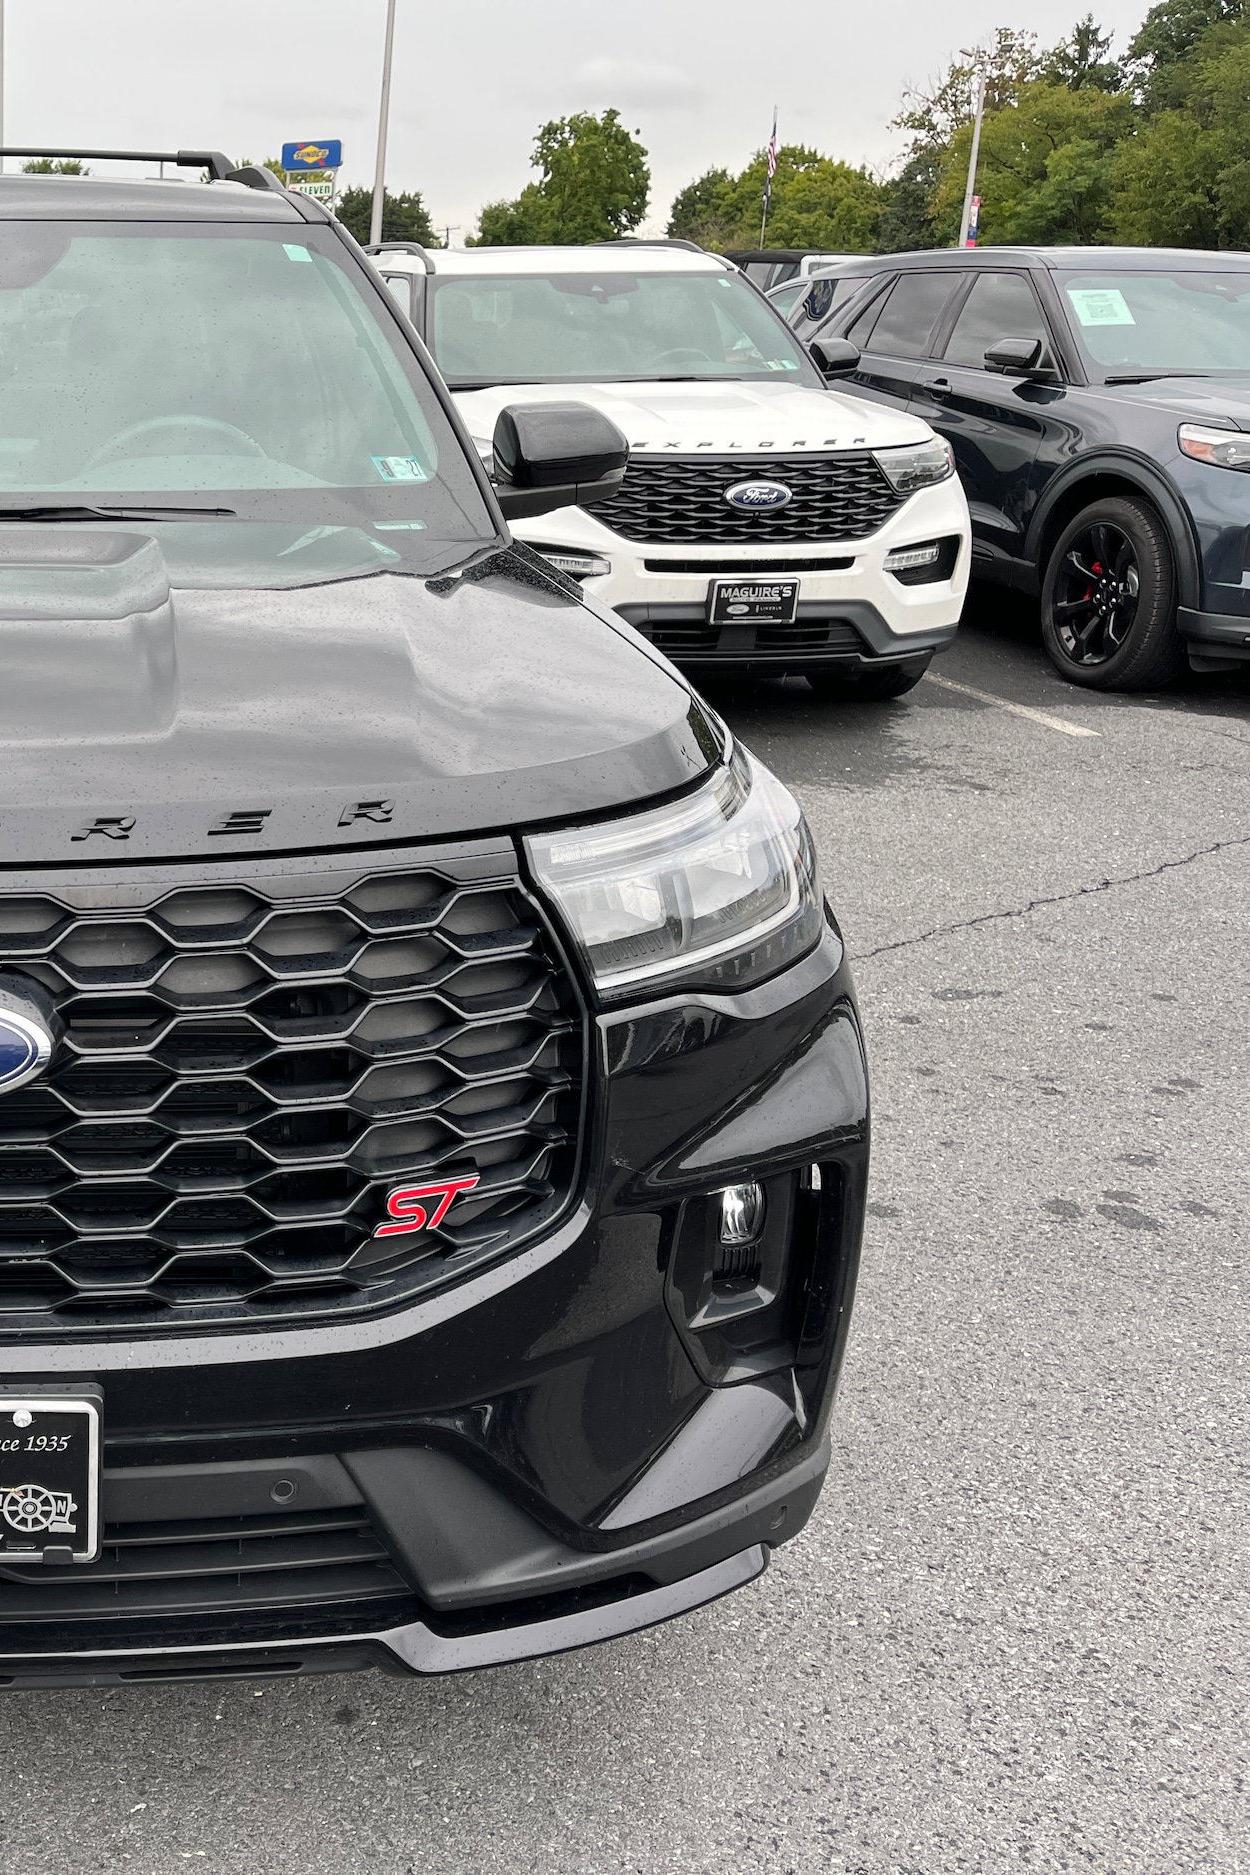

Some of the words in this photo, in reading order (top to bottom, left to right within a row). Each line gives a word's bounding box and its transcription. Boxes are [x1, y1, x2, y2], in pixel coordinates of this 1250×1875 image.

[631, 437, 866, 448] EXPLORER
[742, 487, 778, 503] Ford
[720, 586, 793, 598] MAGUIRE'S
[372, 1174, 481, 1238] ST
[23, 1434, 73, 1452] 1935
